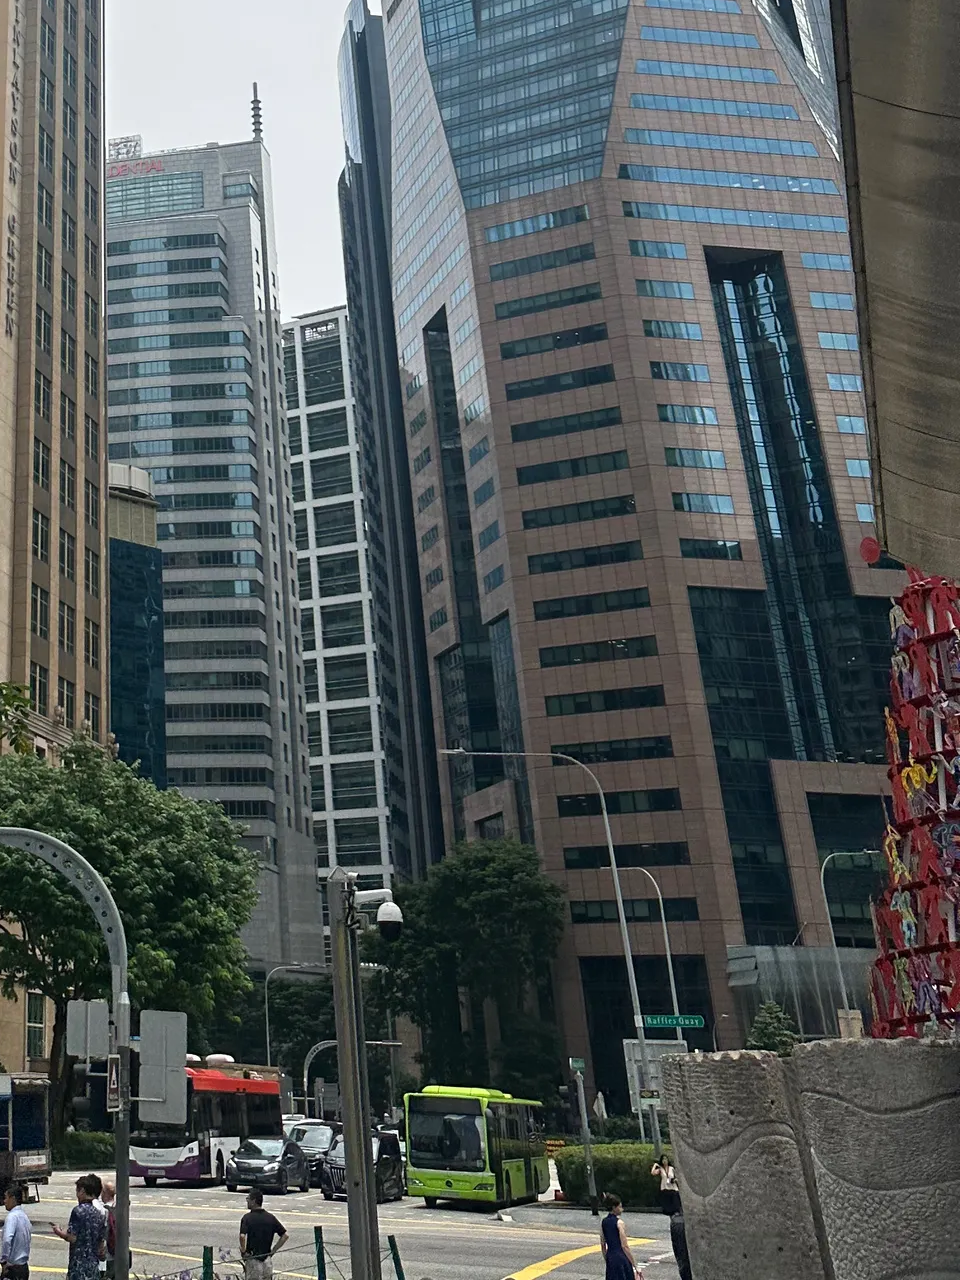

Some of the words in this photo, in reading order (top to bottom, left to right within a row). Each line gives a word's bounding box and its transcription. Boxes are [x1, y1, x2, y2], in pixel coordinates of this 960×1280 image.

[106, 160, 165, 178] DENTIAL
[647, 1017, 677, 1025] Raffles
[678, 1016, 699, 1027] Quay
